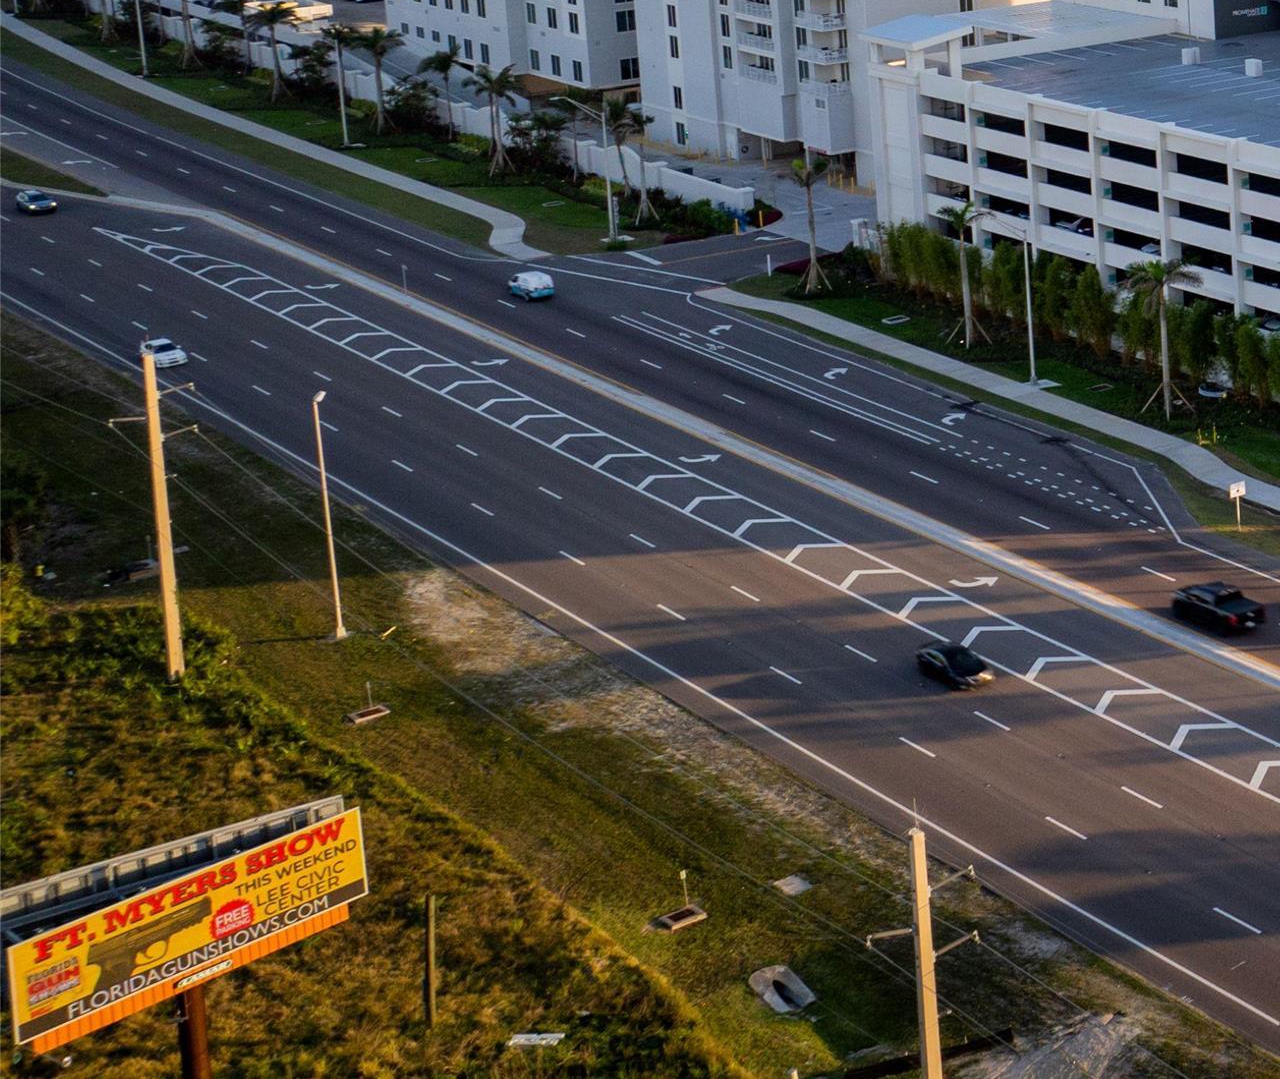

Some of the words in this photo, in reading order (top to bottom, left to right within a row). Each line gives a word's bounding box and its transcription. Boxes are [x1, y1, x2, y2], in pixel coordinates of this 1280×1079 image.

[33, 923, 96, 963] FT.
[103, 861, 236, 934] MYERS
[245, 817, 346, 876] SHOW
[234, 873, 272, 896] THIS
[274, 838, 357, 879] WEEKEND
[256, 884, 293, 907] LEE
[296, 860, 345, 889] CIVIC
[215, 904, 250, 928] FREE
[264, 876, 340, 916] CENTER
[67, 895, 330, 1020] FLORIDAGUNSHOWS.COM
